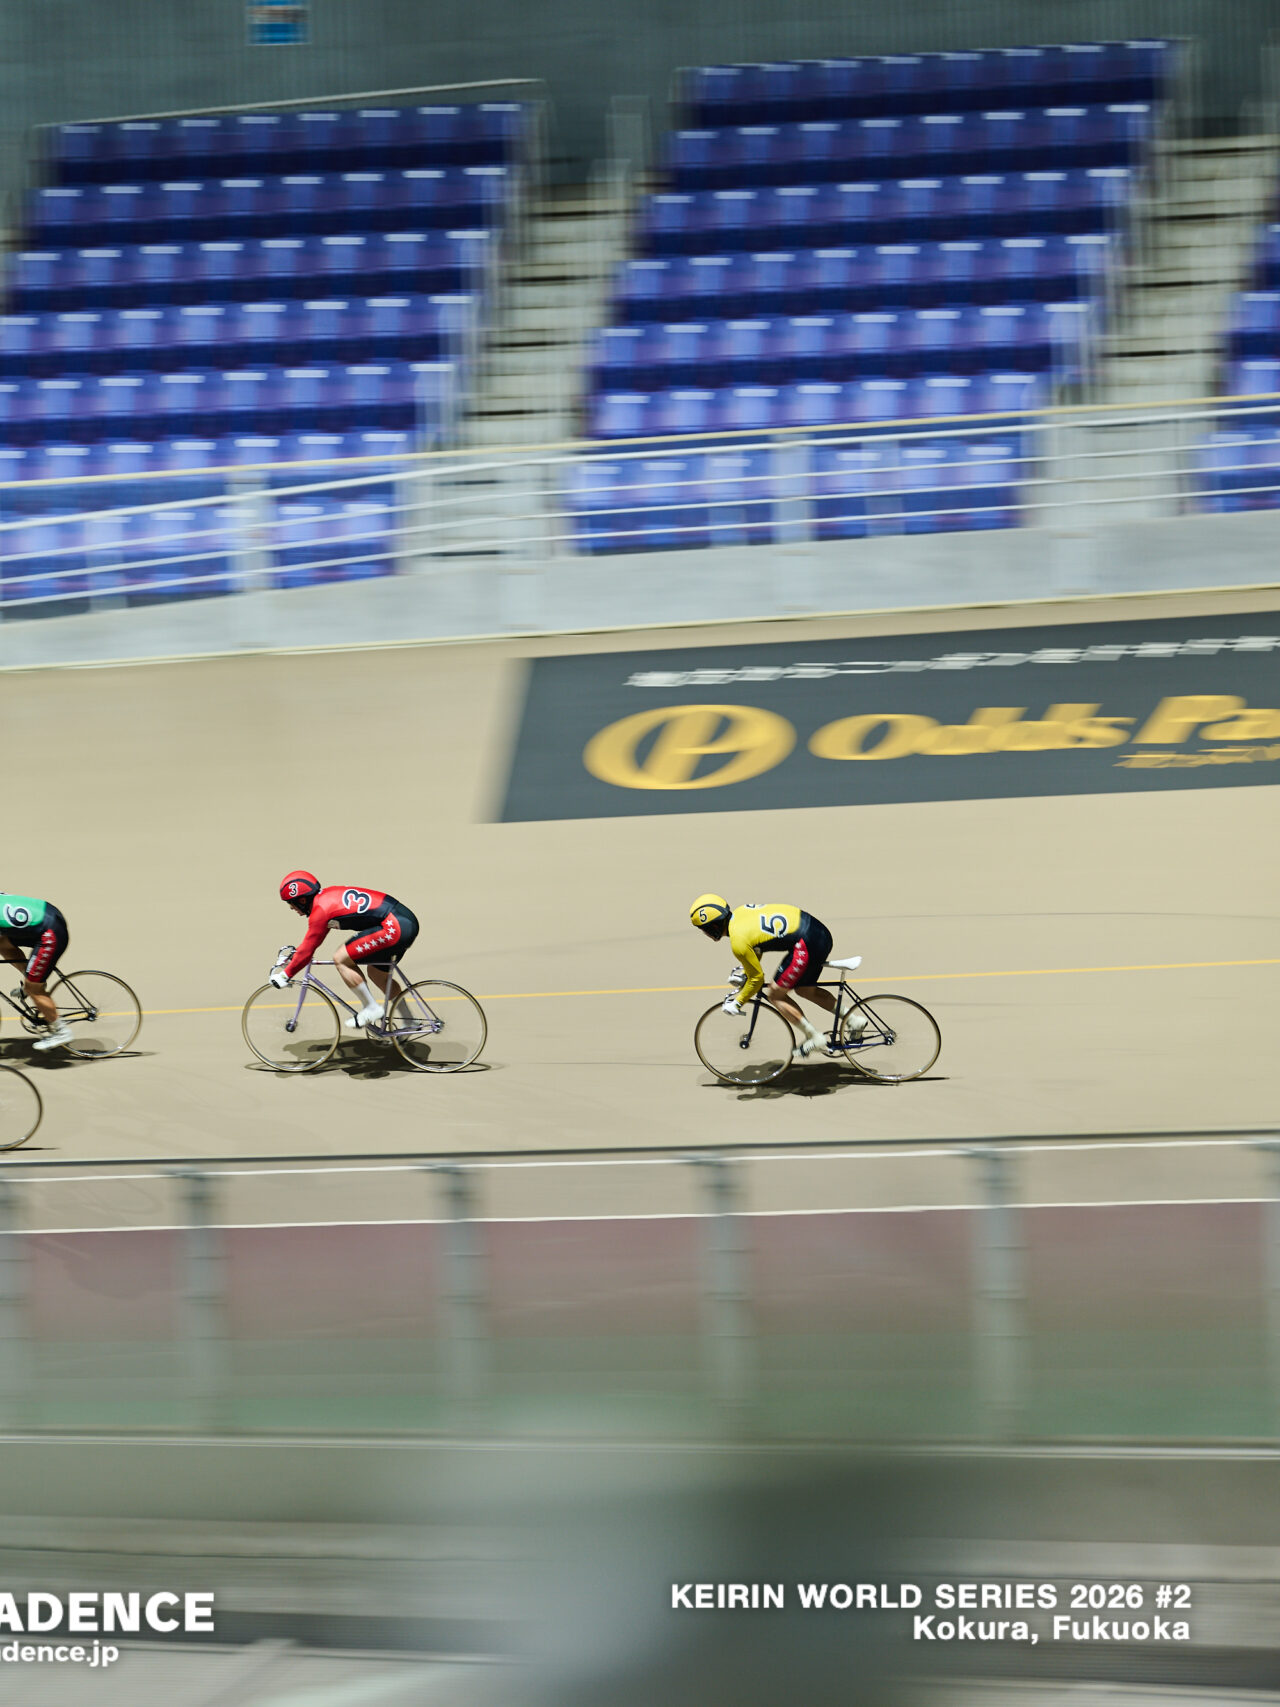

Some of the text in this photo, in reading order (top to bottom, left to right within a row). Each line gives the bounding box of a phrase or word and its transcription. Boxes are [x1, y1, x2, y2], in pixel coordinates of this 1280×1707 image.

[288, 882, 298, 896] 3
[342, 889, 372, 913] 3
[3, 903, 32, 928] 6
[699, 908, 708, 923] 5
[760, 912, 790, 938] 5
